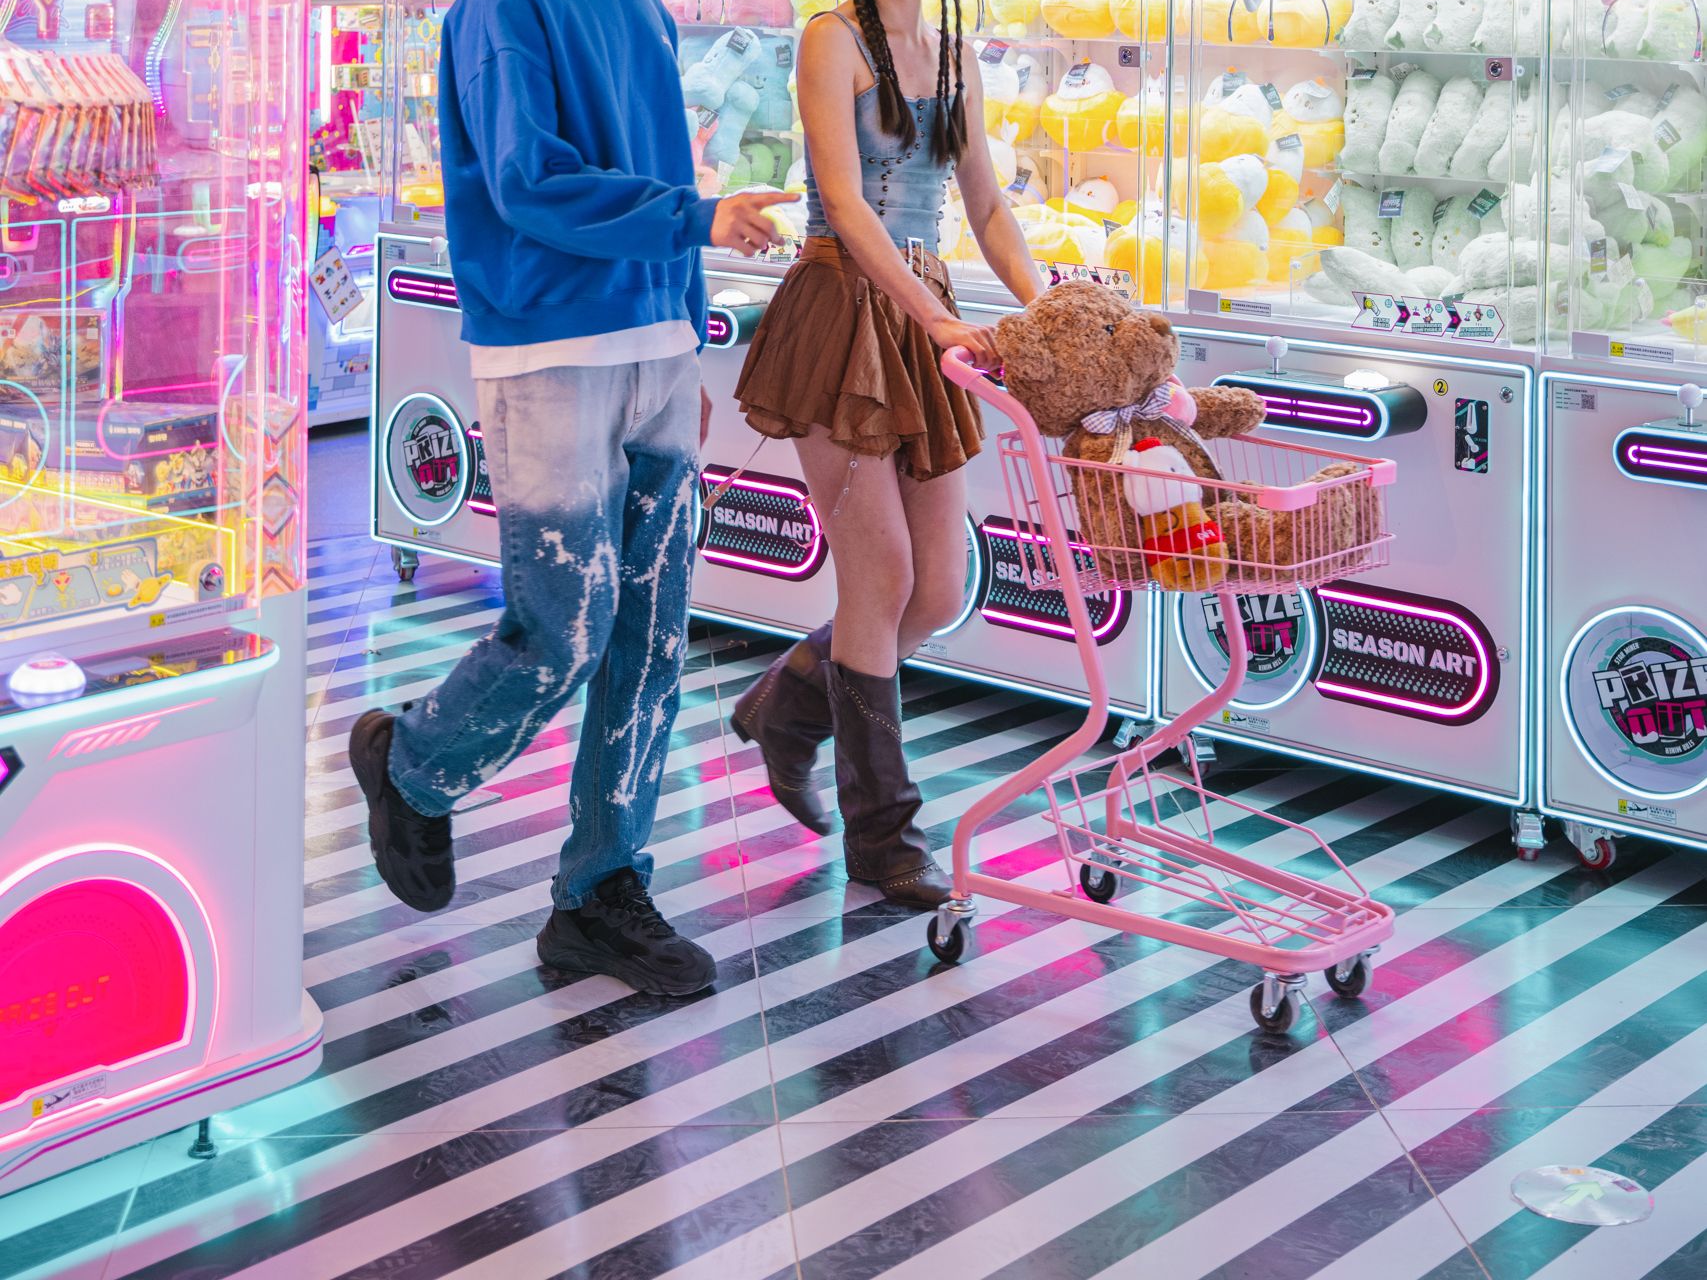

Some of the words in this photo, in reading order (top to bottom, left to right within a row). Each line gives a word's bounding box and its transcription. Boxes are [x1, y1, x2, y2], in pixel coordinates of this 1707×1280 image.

[1436, 380, 1445, 394] 2
[713, 506, 778, 536] SEASON
[780, 520, 814, 542] ART
[1331, 627, 1425, 669] SEASON
[1429, 650, 1478, 678] ART
